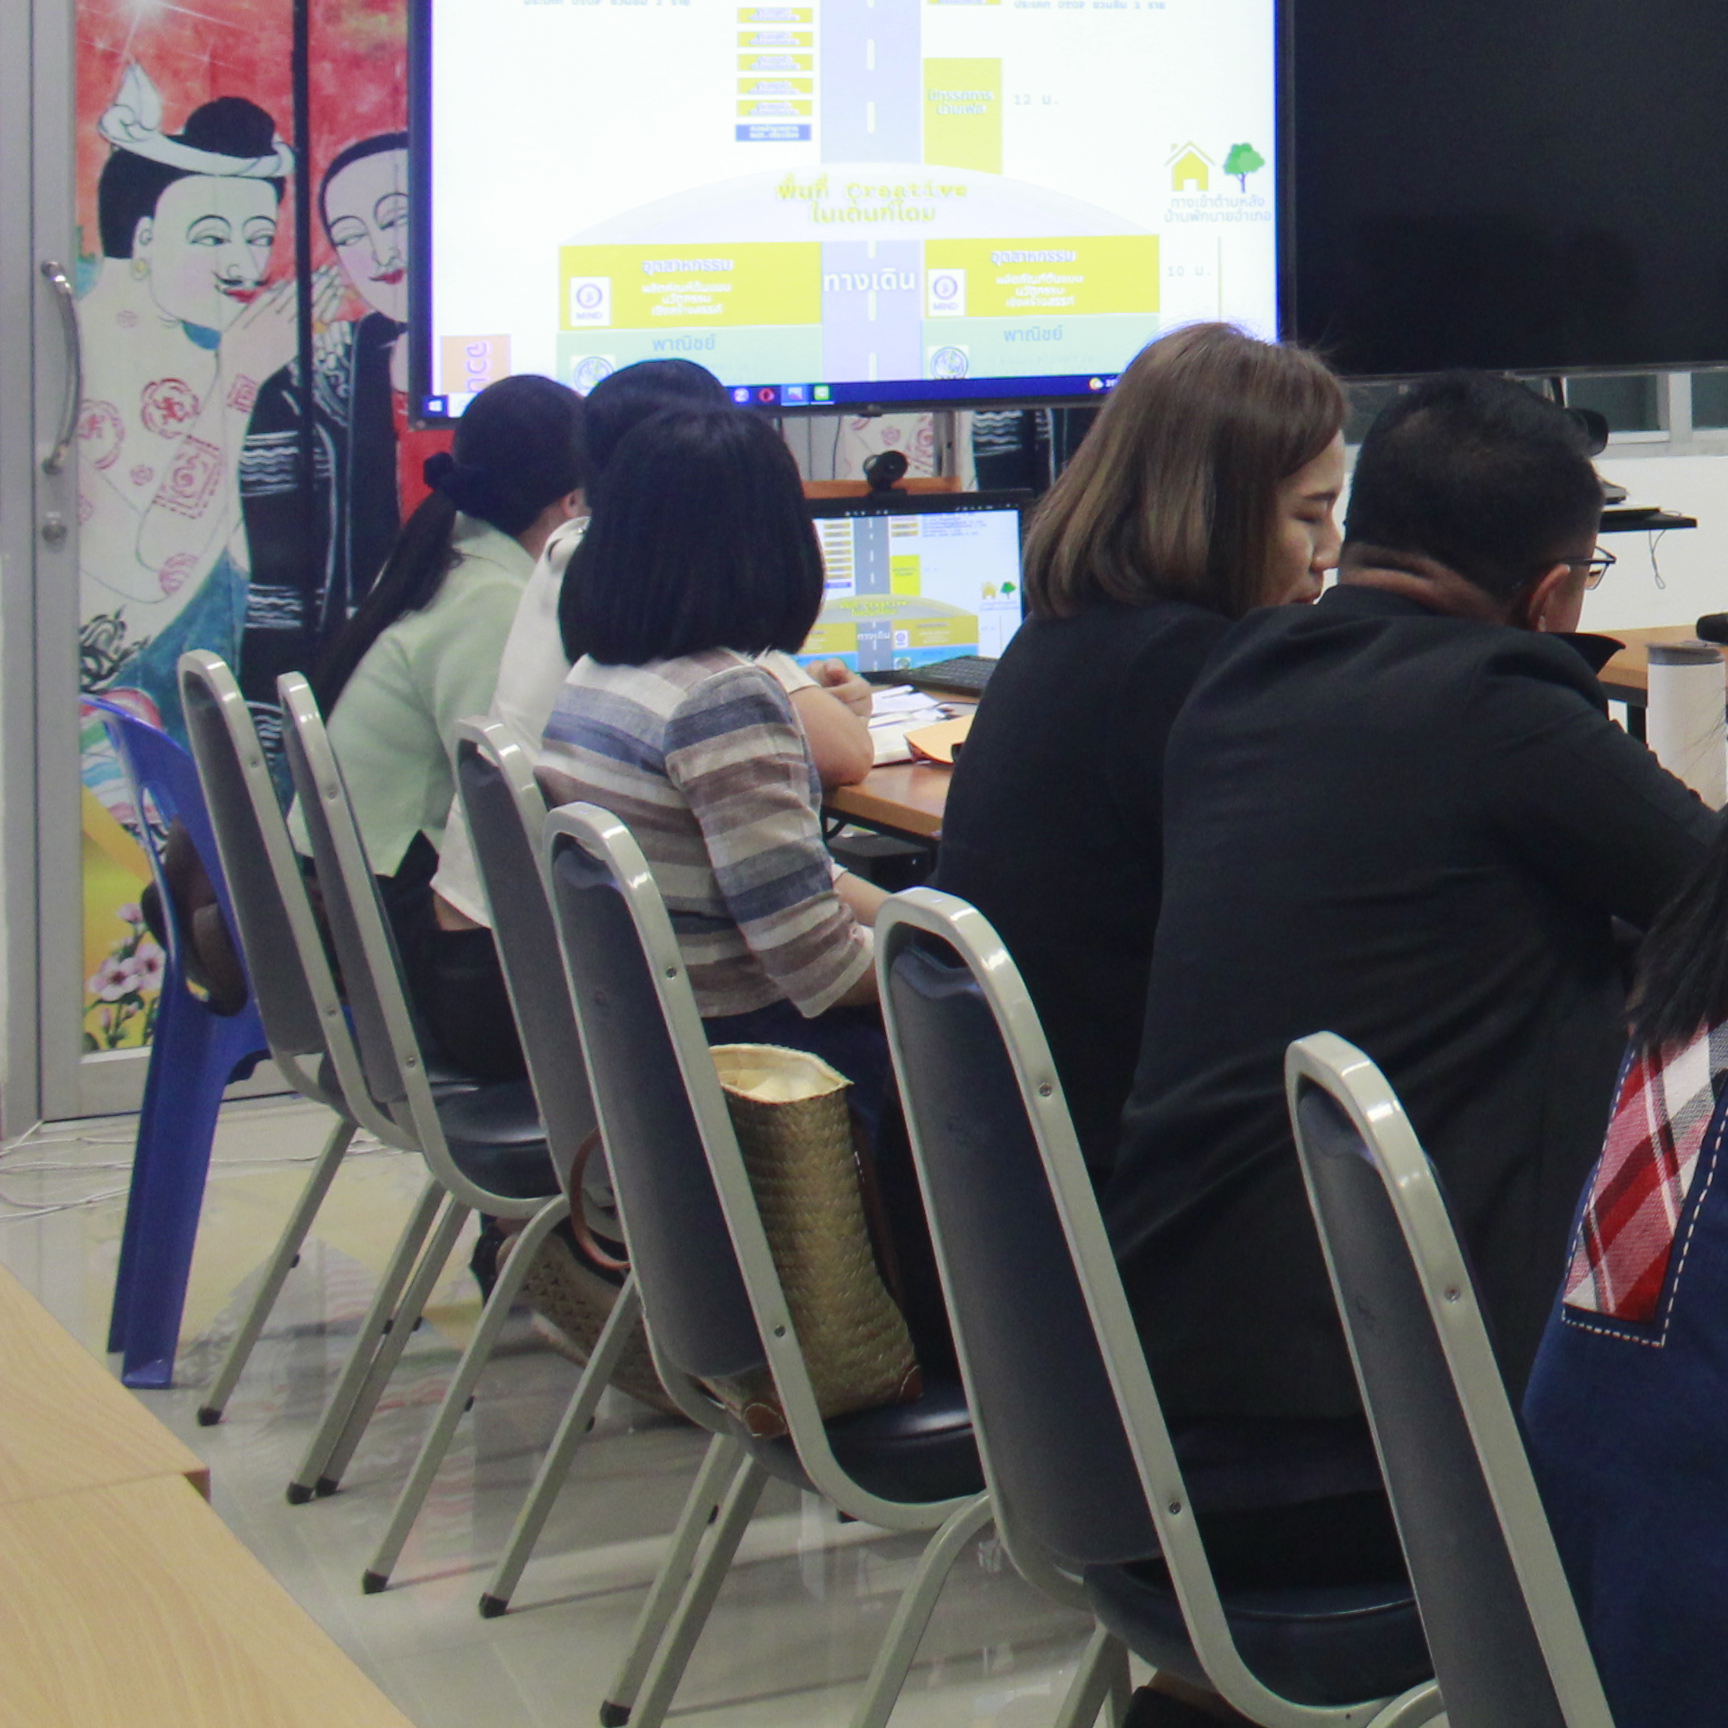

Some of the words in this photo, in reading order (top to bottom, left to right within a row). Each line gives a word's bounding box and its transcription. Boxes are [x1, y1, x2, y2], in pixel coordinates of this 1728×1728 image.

[775, 172, 829, 200] พื้นที่
[845, 179, 968, 199] Creative
[1171, 193, 1265, 208] ทางเข้าด้านหลัง
[1164, 208, 1272, 223] บ้านพักนายอำเภอ
[990, 249, 1077, 266] อุตสาหกรรม
[641, 258, 734, 276] อุตสาหกรรม
[1167, 266, 1185, 277] 10
[823, 265, 917, 294] ทางเดิน
[1004, 325, 1063, 342] พาณิชย์
[652, 333, 716, 352] พาณิชย์
